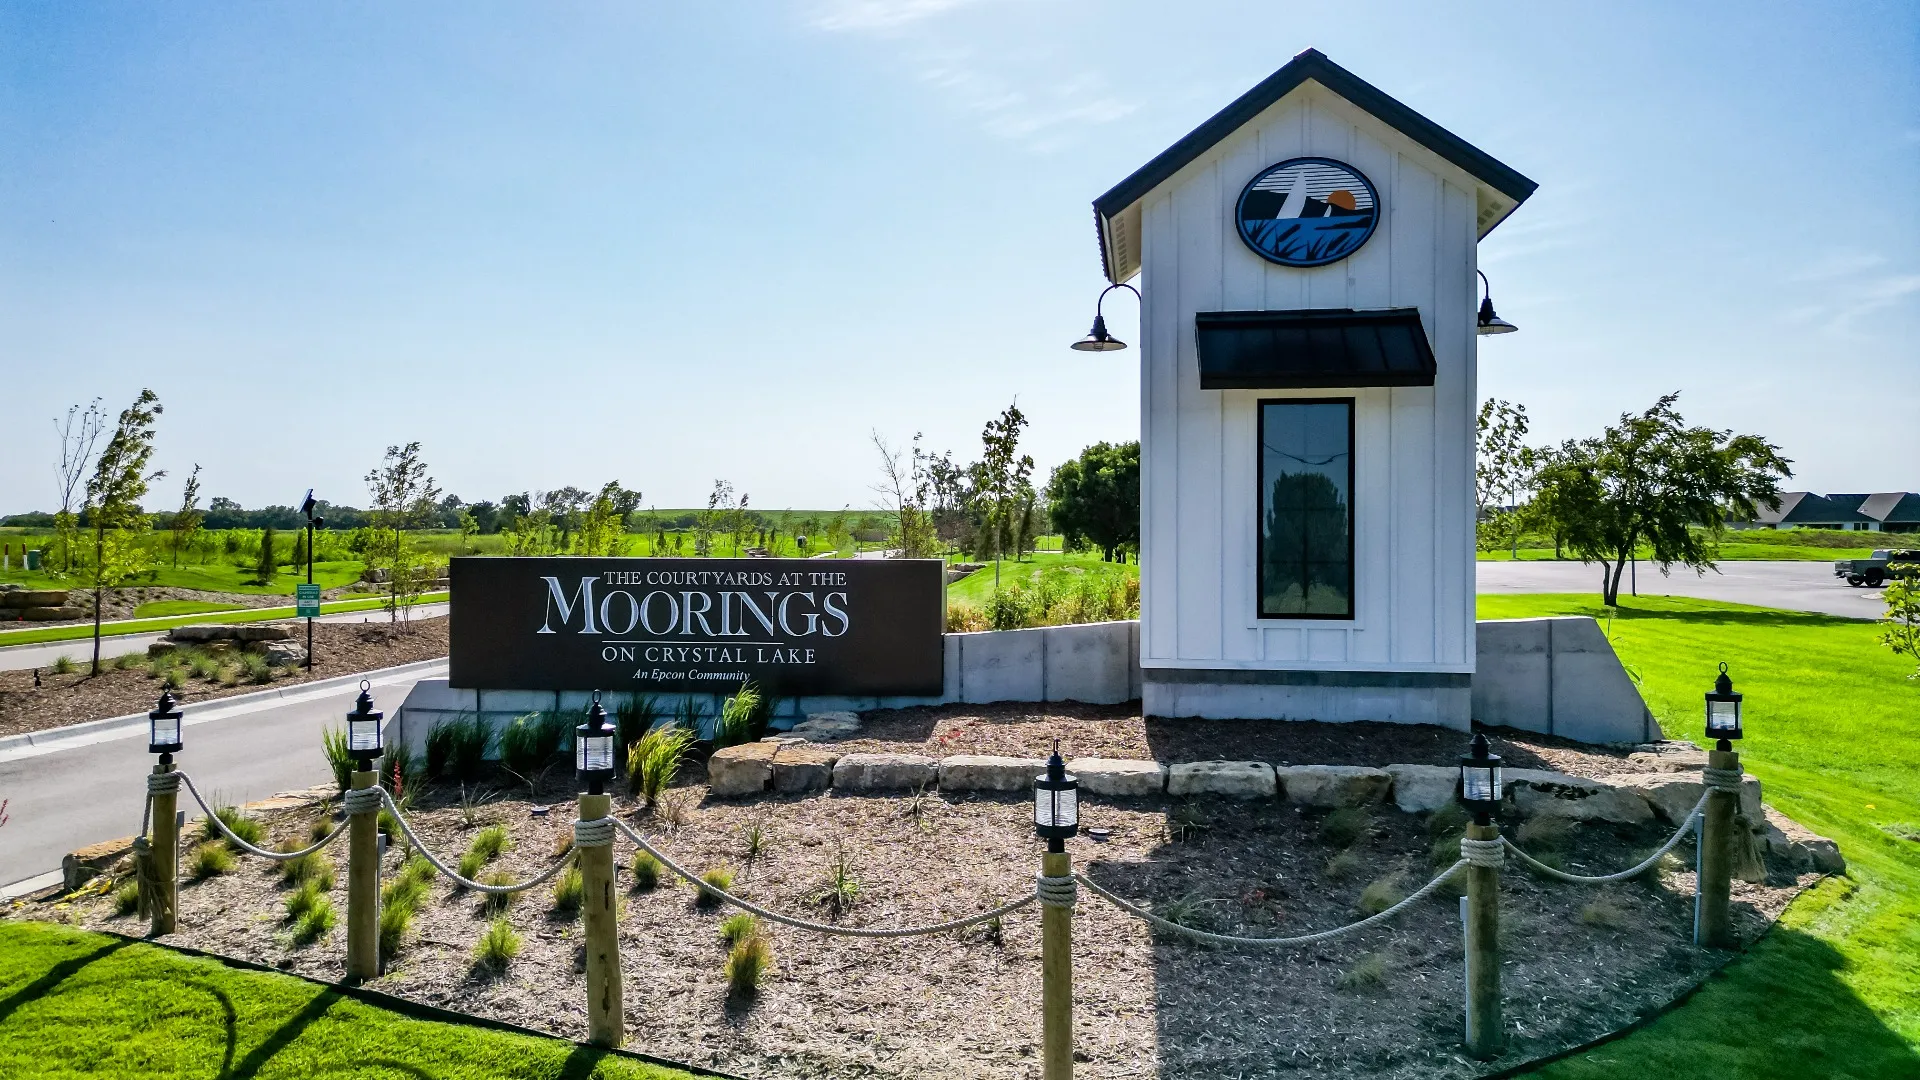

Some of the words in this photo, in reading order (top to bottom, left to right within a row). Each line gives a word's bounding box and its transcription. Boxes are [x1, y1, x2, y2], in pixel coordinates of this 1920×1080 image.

[603, 571, 642, 585] THE
[646, 571, 773, 586] COURTYARDS
[777, 572, 803, 586] AT
[808, 572, 847, 586] THE
[536, 576, 849, 637] MOORINGS
[602, 646, 635, 662] ON
[645, 647, 747, 663] CRYSTAL
[757, 648, 816, 664] LAKE
[632, 668, 648, 679] An
[651, 668, 685, 682] Epcon
[688, 668, 751, 681] Community
